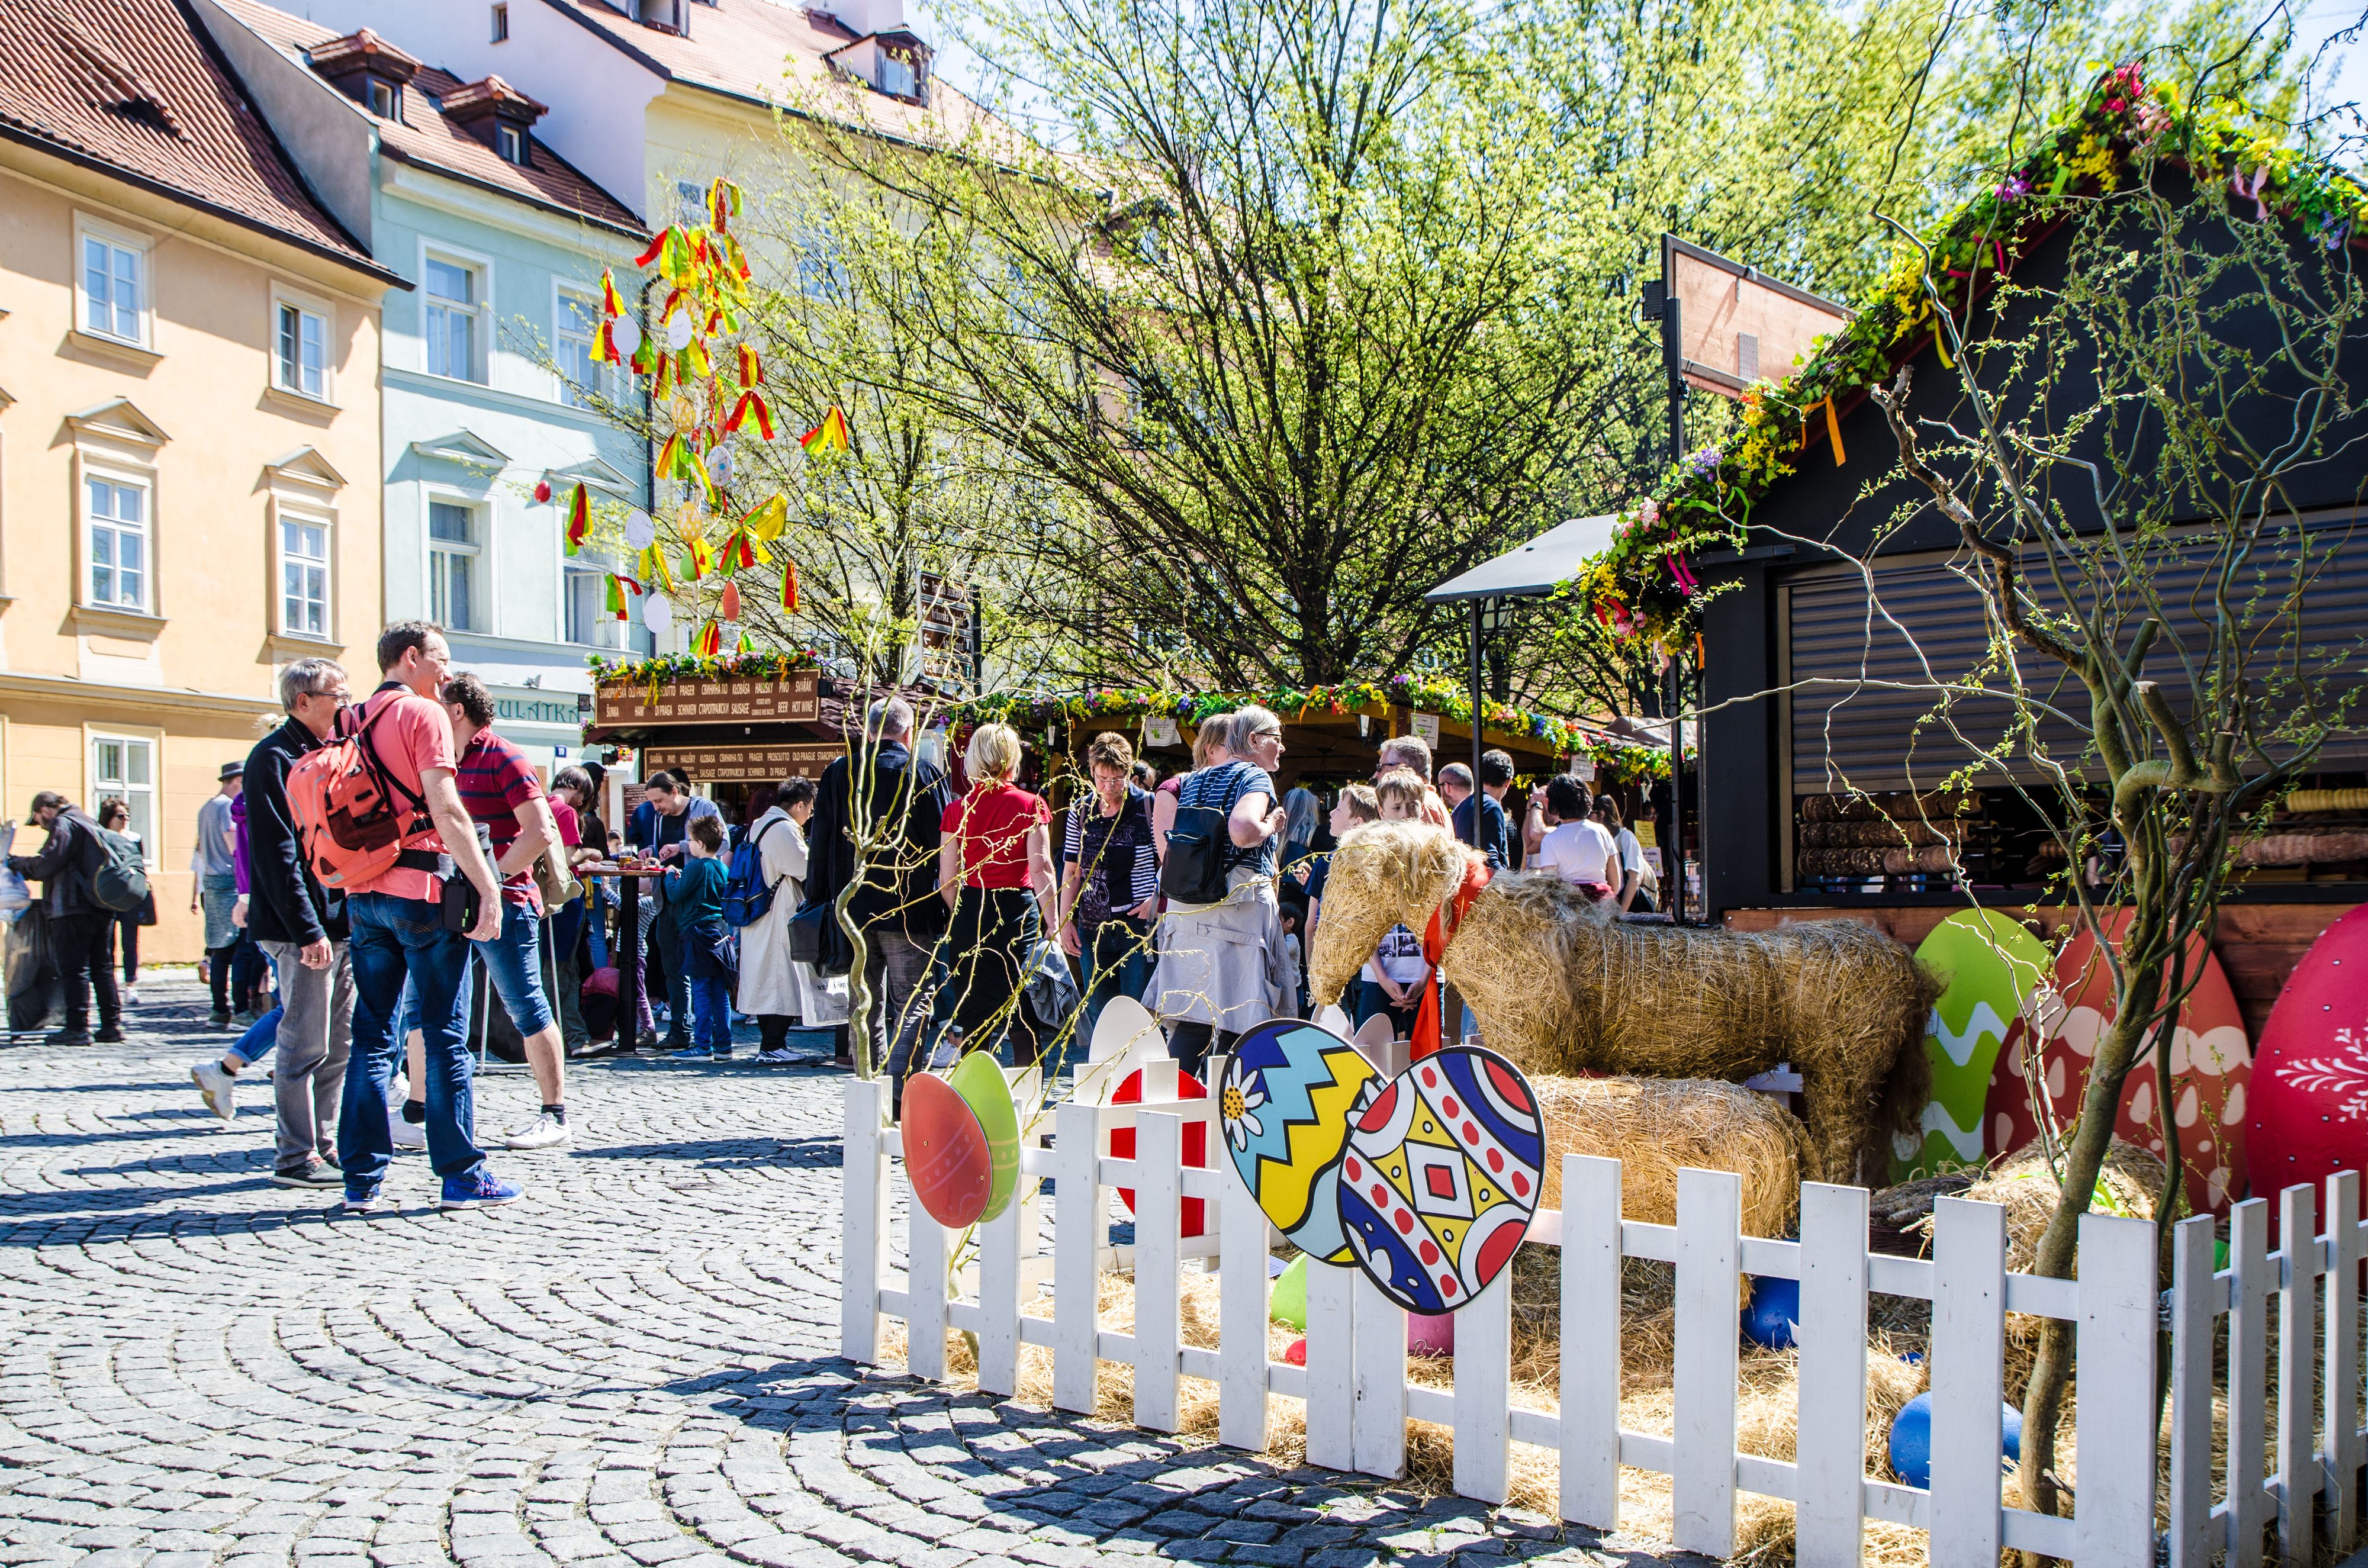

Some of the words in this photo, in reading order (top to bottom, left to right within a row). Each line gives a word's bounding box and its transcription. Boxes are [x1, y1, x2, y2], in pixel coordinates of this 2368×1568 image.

[680, 685, 695, 696] PRAGER
[779, 682, 789, 693] PIVO
[795, 677, 812, 693] SVAŘÁK
[606, 703, 619, 717] ŠUNKA
[635, 706, 644, 716] HAM
[655, 705, 659, 716] DI
[659, 704, 673, 716] PRAGA
[678, 704, 696, 715] SCHINKEN
[731, 703, 749, 715] SAUSAGE
[778, 701, 788, 713] BEER
[792, 701, 801, 712] HOT
[801, 700, 813, 712] WINE
[650, 753, 662, 764] SVAŘÁK
[680, 752, 696, 763] HALUŠKY
[749, 753, 763, 761] PRAGER
[767, 752, 790, 761] PROSCIUTTO
[801, 752, 816, 761] PRAGUE
[700, 769, 715, 777] SAUSAGE
[748, 768, 765, 777] SCHINKEN
[770, 768, 774, 776] DI
[774, 768, 787, 776] PRAGA
[799, 767, 809, 775] HAM
